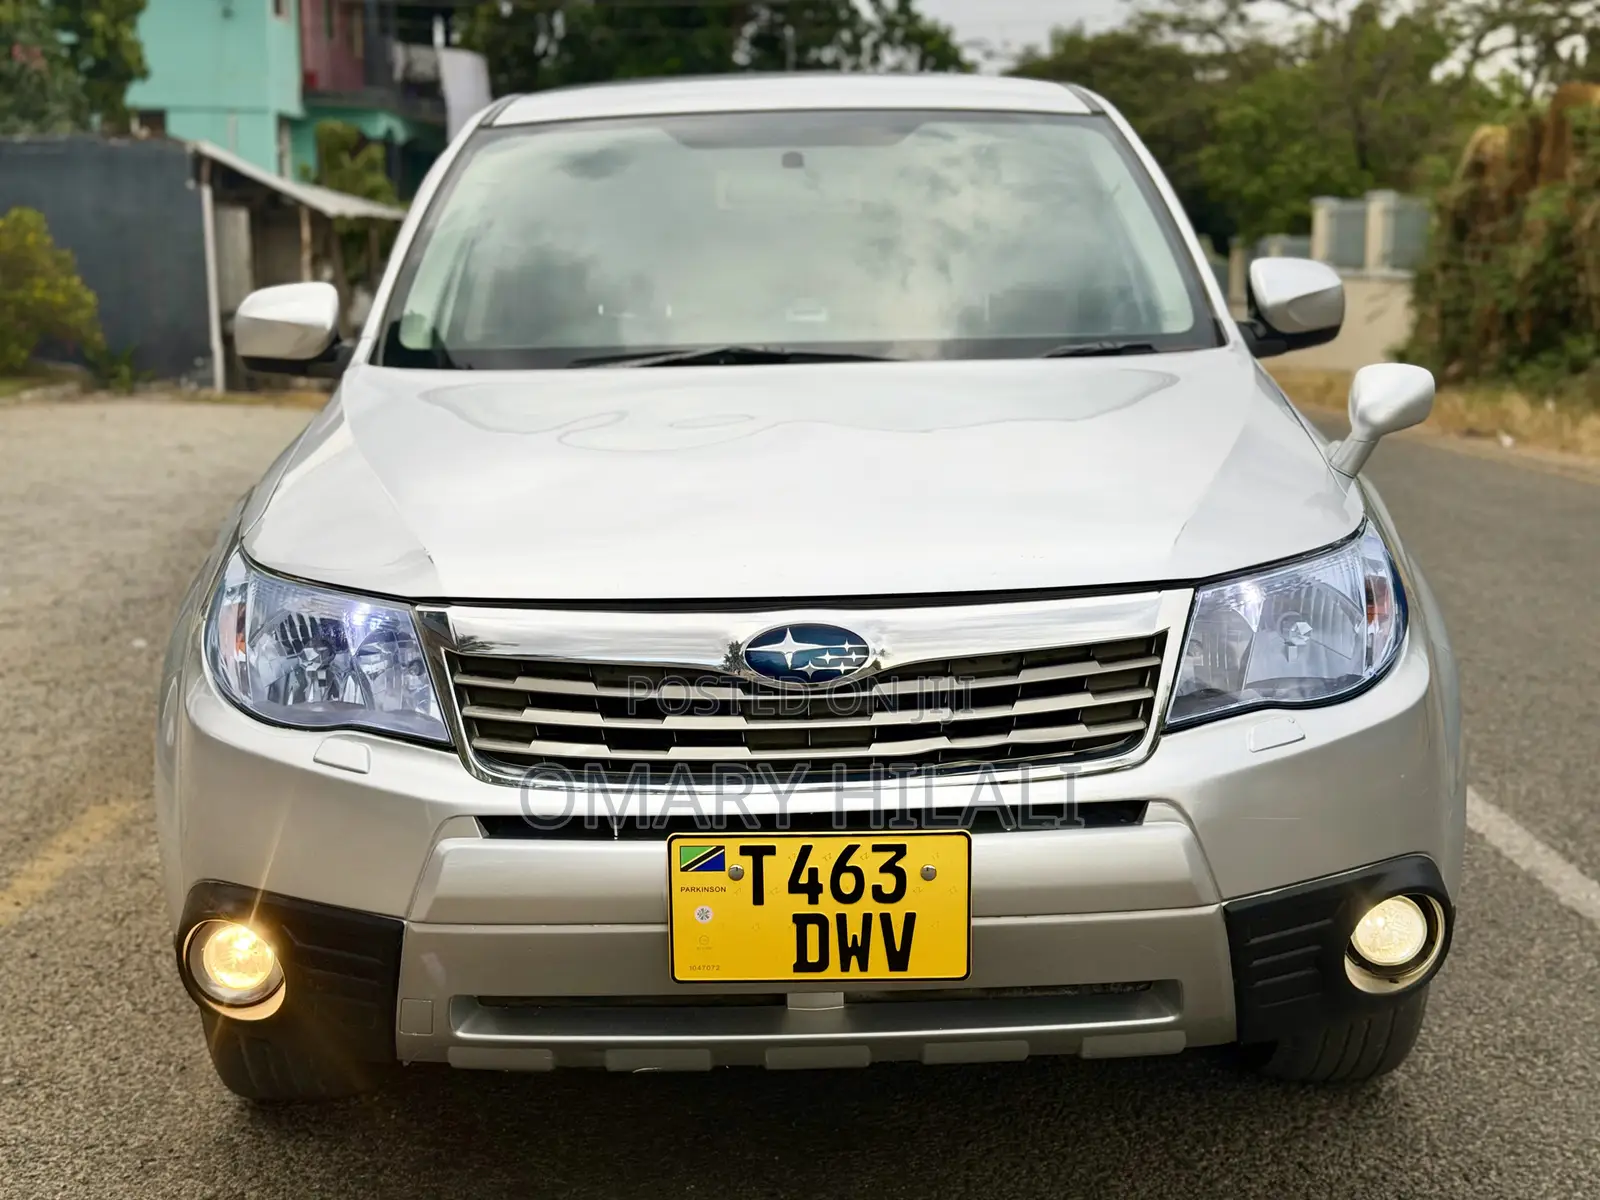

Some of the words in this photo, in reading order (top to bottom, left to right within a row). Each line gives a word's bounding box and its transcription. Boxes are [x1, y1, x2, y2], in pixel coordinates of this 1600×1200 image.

[739, 844, 777, 906] T
[787, 843, 907, 905] 463
[792, 912, 917, 973] DWV
